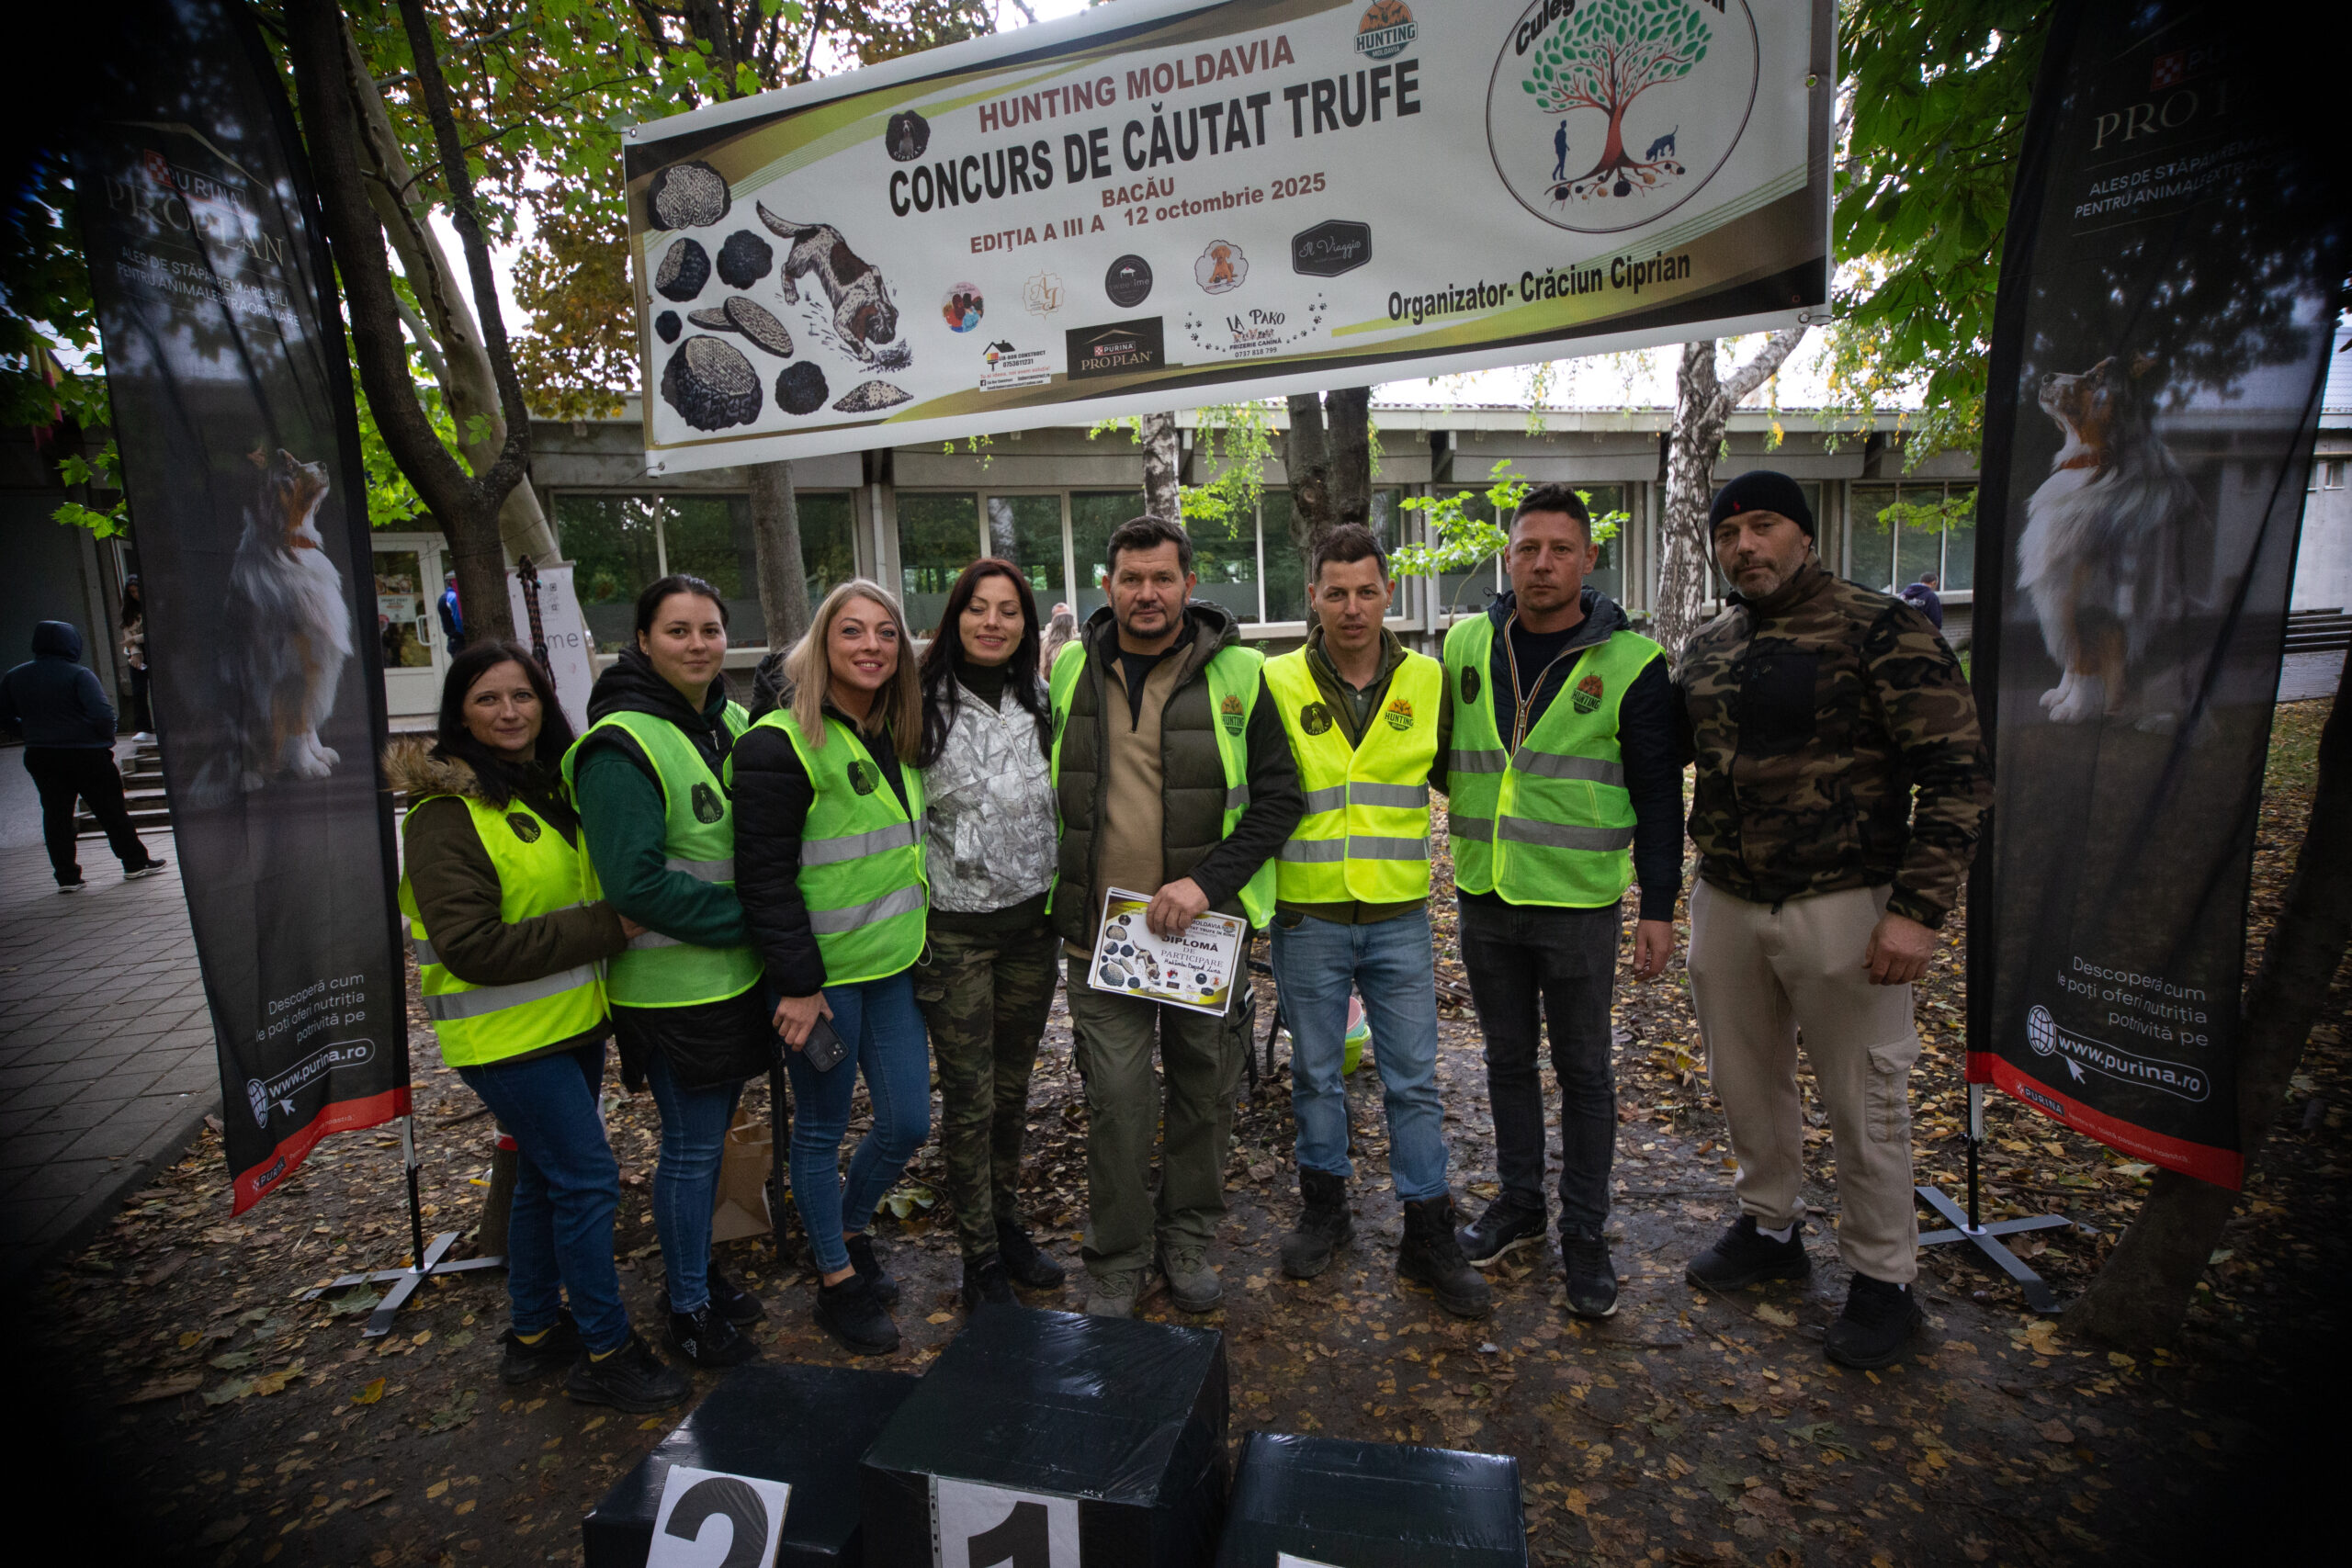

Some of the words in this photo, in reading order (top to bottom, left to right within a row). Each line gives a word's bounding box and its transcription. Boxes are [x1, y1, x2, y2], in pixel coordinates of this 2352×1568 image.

[1356, 24, 1416, 51] HUNTING
[1373, 45, 1400, 57] MOLDAVIA
[978, 75, 1116, 133] HUNTING
[1127, 34, 1295, 101] MOLDAVIA
[889, 139, 1054, 217] CONCURS
[1066, 127, 1111, 184] DE
[1124, 92, 1272, 172] CĂUTAT
[1285, 58, 1421, 139] TRUFE
[1102, 176, 1175, 208] BACĂU
[2088, 174, 2128, 197] ALES
[2131, 168, 2152, 186] DE
[1043, 223, 1057, 242] A
[1063, 218, 1083, 238] III
[1091, 214, 1105, 233] A
[1124, 206, 1148, 226] 12
[1155, 186, 1264, 221] octombrie
[1271, 172, 1326, 200] 2025
[2074, 192, 2132, 220] PENTRU
[121, 245, 147, 265] ALES
[150, 255, 169, 272] DE
[1317, 236, 1362, 259] Viaggio
[158, 277, 219, 302] ANIMALE
[1109, 277, 1149, 291] sweeime
[1388, 279, 1514, 325] Organizator-
[1521, 265, 1603, 302] Crăciun
[1610, 251, 1691, 294] Ciprian
[1227, 314, 1245, 334] LA
[1103, 343, 1134, 353] PURINA
[1229, 342, 1257, 350] FRIZERIE
[1252, 348, 1264, 356] 818
[1385, 711, 1414, 728] HUNTING
[1161, 936, 1218, 952] DIPLOMĂ
[1161, 949, 1224, 968] PARTICIPARE
[2057, 970, 2066, 986] le
[2102, 988, 2143, 1009] oferi
[2073, 955, 2163, 992] Descoperă
[2164, 983, 2205, 1001] cum
[268, 979, 325, 1015] Descoperă
[330, 974, 364, 989] cum
[291, 1003, 312, 1024] oferi
[296, 1012, 339, 1045] potrivită
[345, 1010, 366, 1026] pe
[2109, 1011, 2173, 1042] potrivită
[2180, 1031, 2209, 1046] pe
[268, 1044, 367, 1099] www.purina.ro
[2057, 1033, 2201, 1092] www.purina.ro
[2024, 1089, 2064, 1115] PURINA
[663, 1477, 769, 1568] 2
[967, 1501, 1050, 1568] 1
